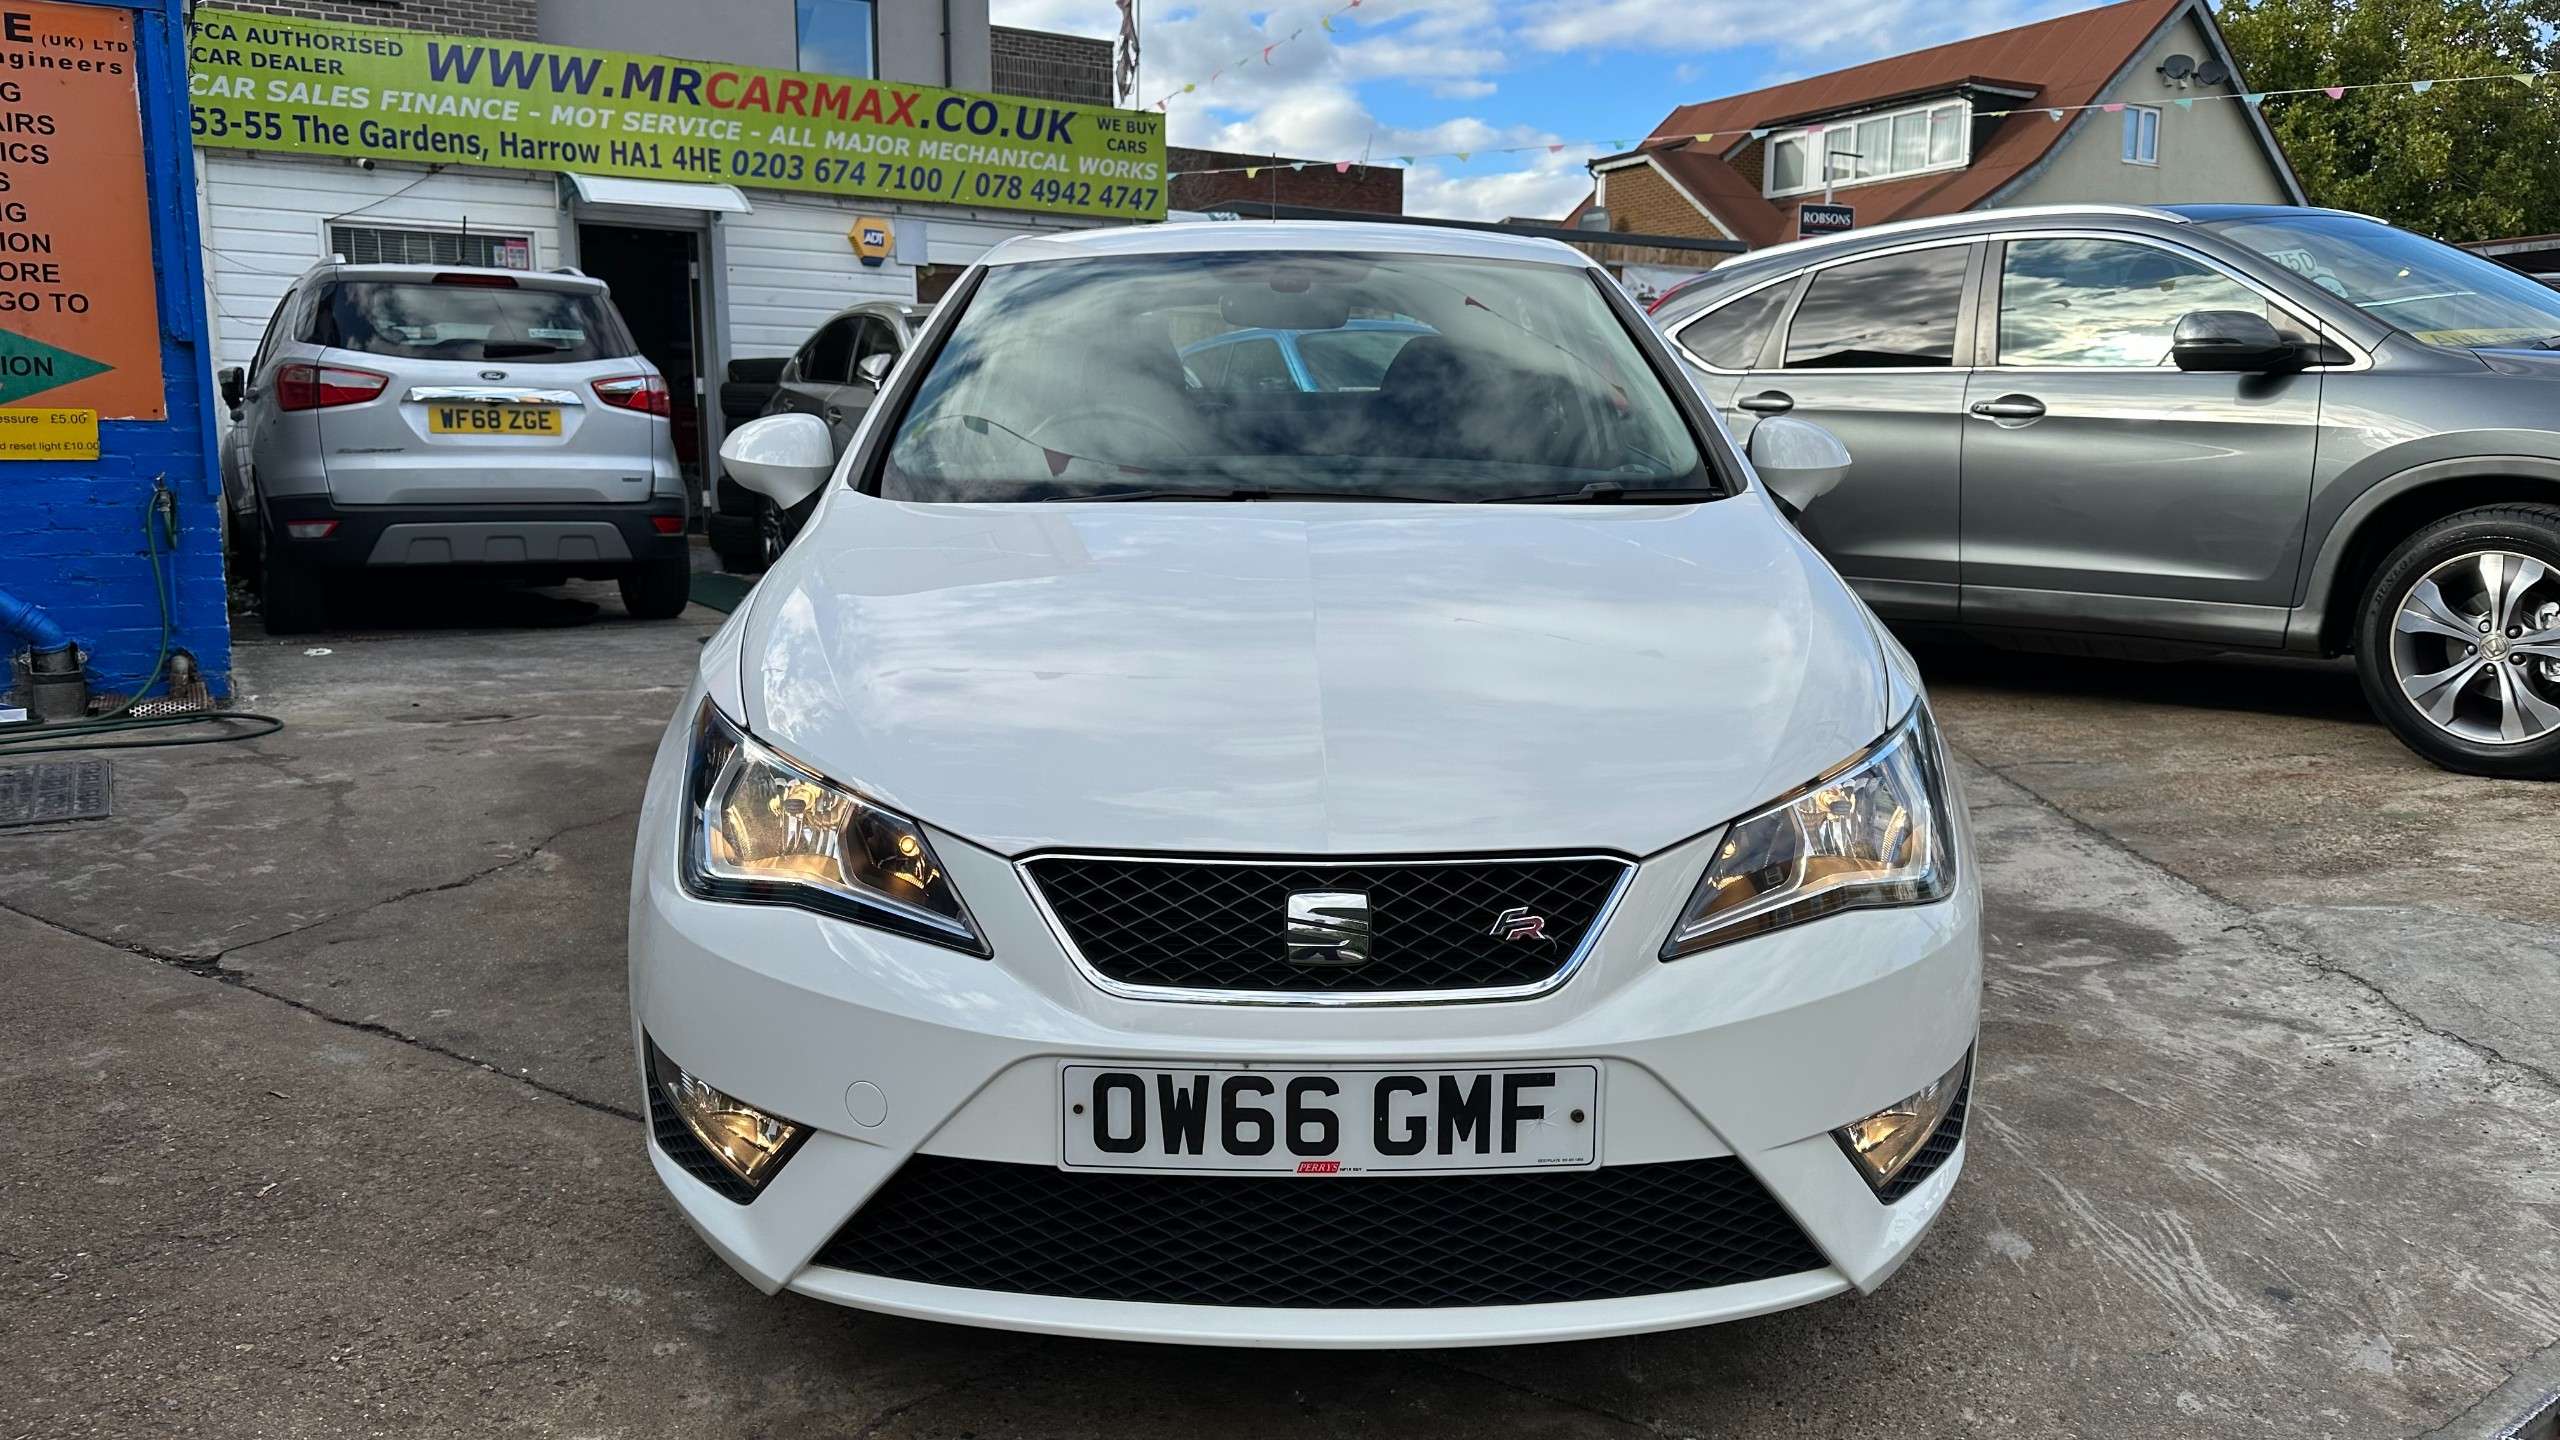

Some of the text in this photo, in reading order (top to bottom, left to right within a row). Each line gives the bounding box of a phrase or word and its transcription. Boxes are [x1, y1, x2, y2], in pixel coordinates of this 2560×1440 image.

[4, 12, 128, 52] E (UK) LTD
[192, 22, 404, 57] FCA AUTHORISED
[193, 47, 344, 75] CAR DEALER
[427, 42, 1078, 144] WWW.MRCARMAX.CO.UK
[0, 112, 55, 135] IRS
[190, 74, 256, 100] CAR
[266, 80, 369, 109] SALES
[380, 90, 520, 121] FINANCE
[550, 105, 615, 129] MOT
[622, 112, 742, 140] SERVICE
[768, 126, 816, 148] ALL
[825, 130, 910, 157] MAJOR
[918, 139, 1070, 173] MECHANICAL
[1079, 156, 1159, 181] WORKS
[1097, 117, 1157, 136] WE BUY
[1107, 138, 1147, 154] CARS
[191, 104, 1159, 211] 53-55 The Gardens, Harrow HA1 4HE 0203 674 7100 / 078 4942 4747
[0, 203, 27, 222] G
[1803, 211, 1852, 226] ROBSONS
[864, 231, 885, 245] ADT
[0, 262, 60, 283] ORE
[0, 291, 89, 314] GO TO
[1, 356, 53, 377] ION
[0, 413, 88, 425] ssure £5.00
[440, 408, 552, 430] WF68 ZGE
[9, 441, 37, 450] reset
[39, 441, 62, 452] light
[64, 441, 99, 450] £10.00
[1092, 1072, 1556, 1157] OW66 GMF
[1299, 1162, 1339, 1172] PERRYS
